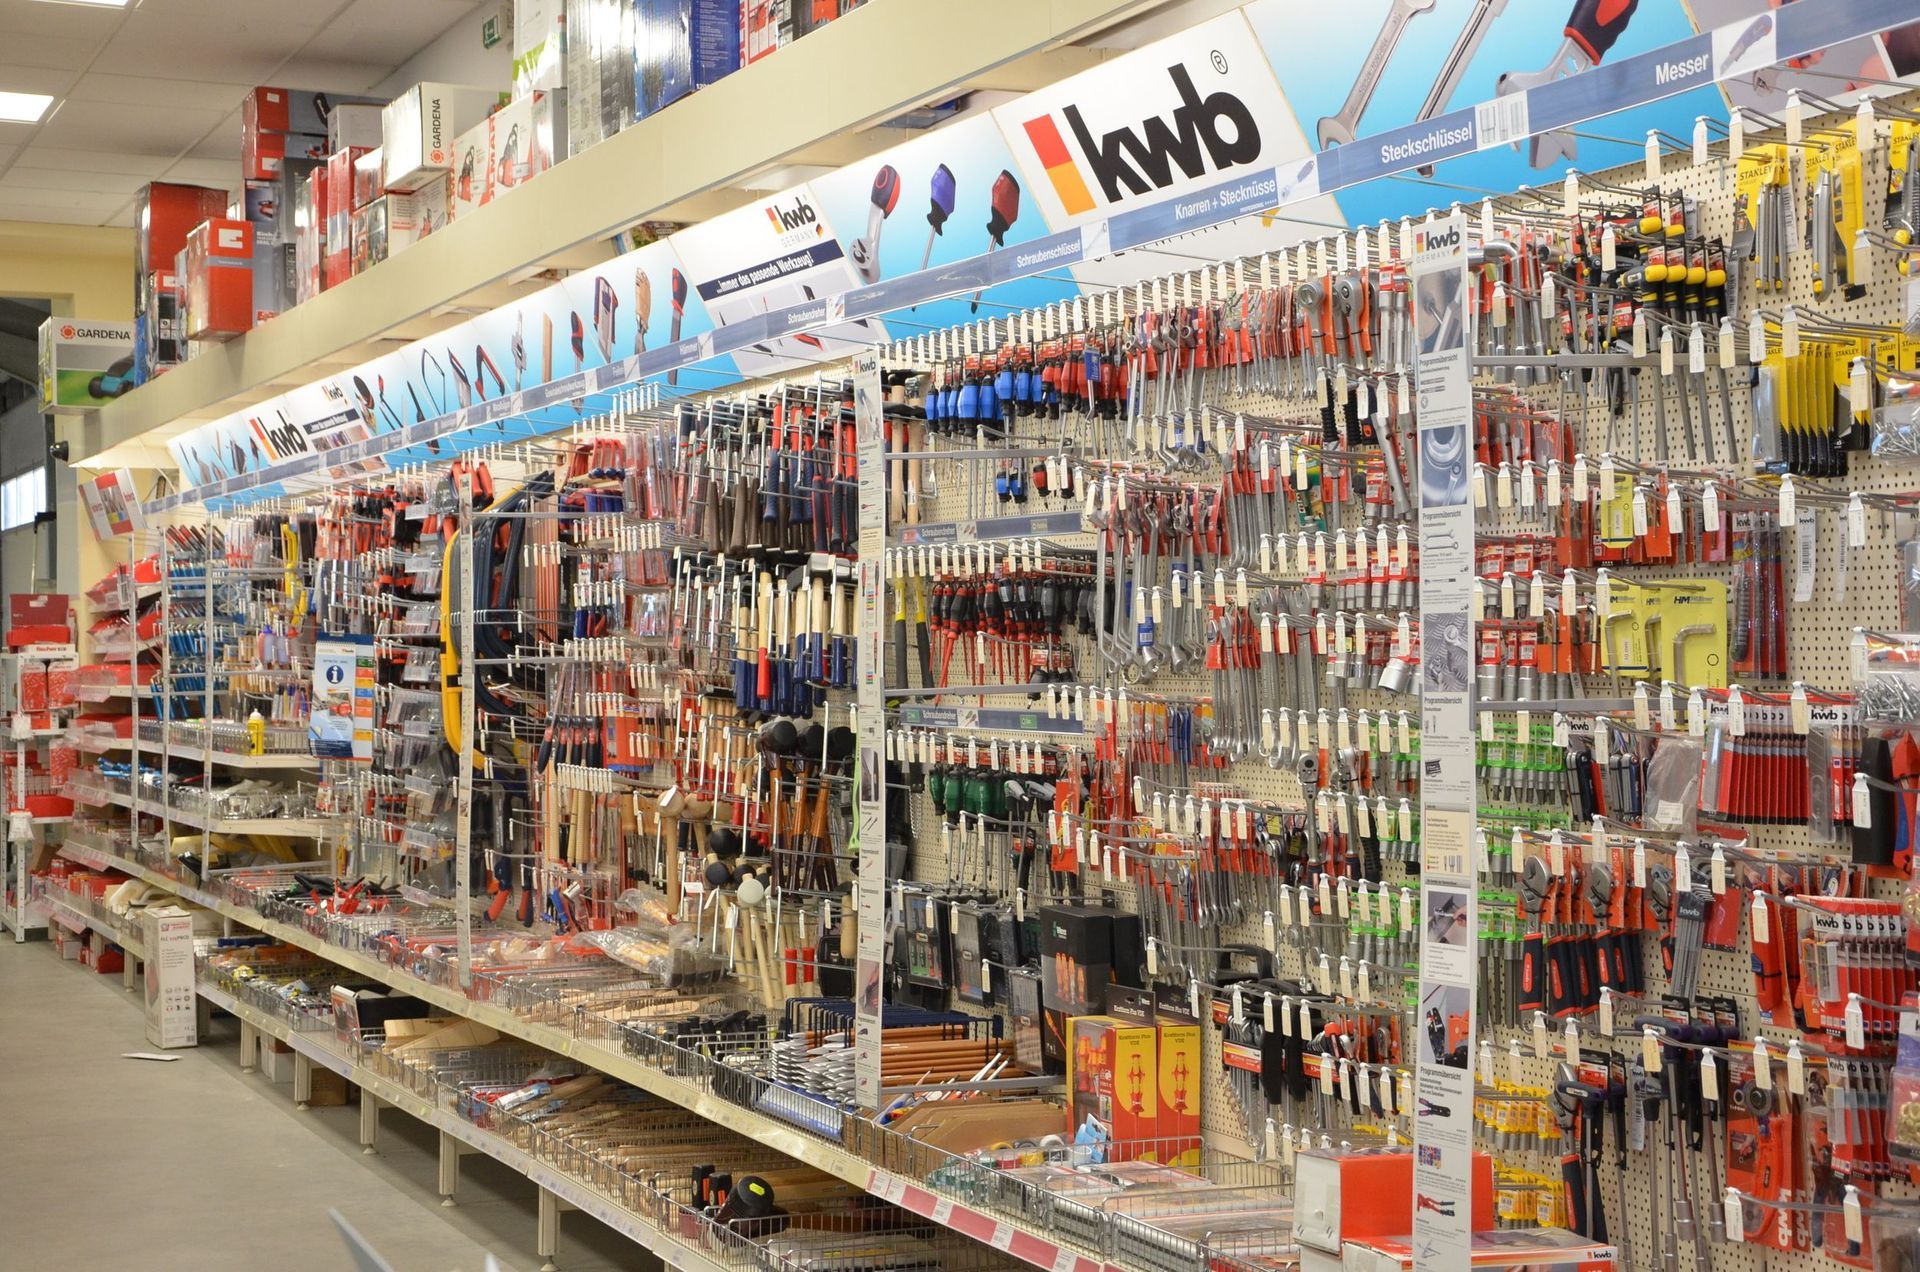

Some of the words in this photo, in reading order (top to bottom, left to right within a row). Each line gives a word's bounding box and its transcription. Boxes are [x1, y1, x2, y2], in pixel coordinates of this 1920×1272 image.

[1655, 51, 1709, 86] Messer
[432, 98, 441, 149] GARDENA
[1062, 63, 1262, 203] kwb
[1381, 121, 1473, 164] Steckschlüssel
[1806, 152, 1830, 169] STANLEY
[1739, 165, 1772, 182] STANLEY
[1175, 197, 1209, 221] Knarren
[1219, 177, 1277, 206] Stecknüsse
[774, 196, 816, 232] kwb
[1426, 225, 1461, 251] kwb
[1016, 237, 1082, 270] Schraubenschlüssel
[738, 272, 750, 286] das
[749, 263, 779, 285] passende
[779, 250, 815, 273] Werkzeug!
[787, 304, 826, 325] Schraubendreher
[77, 328, 131, 341] GARDENA
[1835, 348, 1860, 358] STANLEY
[860, 356, 877, 374] kwb
[257, 409, 308, 459] kwb
[1673, 596, 1691, 604] HM
[1811, 707, 1838, 721] kwb
[1570, 721, 1590, 731] kwb
[1679, 906, 1700, 916] kwb
[1816, 915, 1839, 928] kwb
[1420, 1065, 1462, 1081] Programmübersicht
[1777, 1187, 1792, 1248] kwb
[1594, 1251, 1612, 1259] kwb
